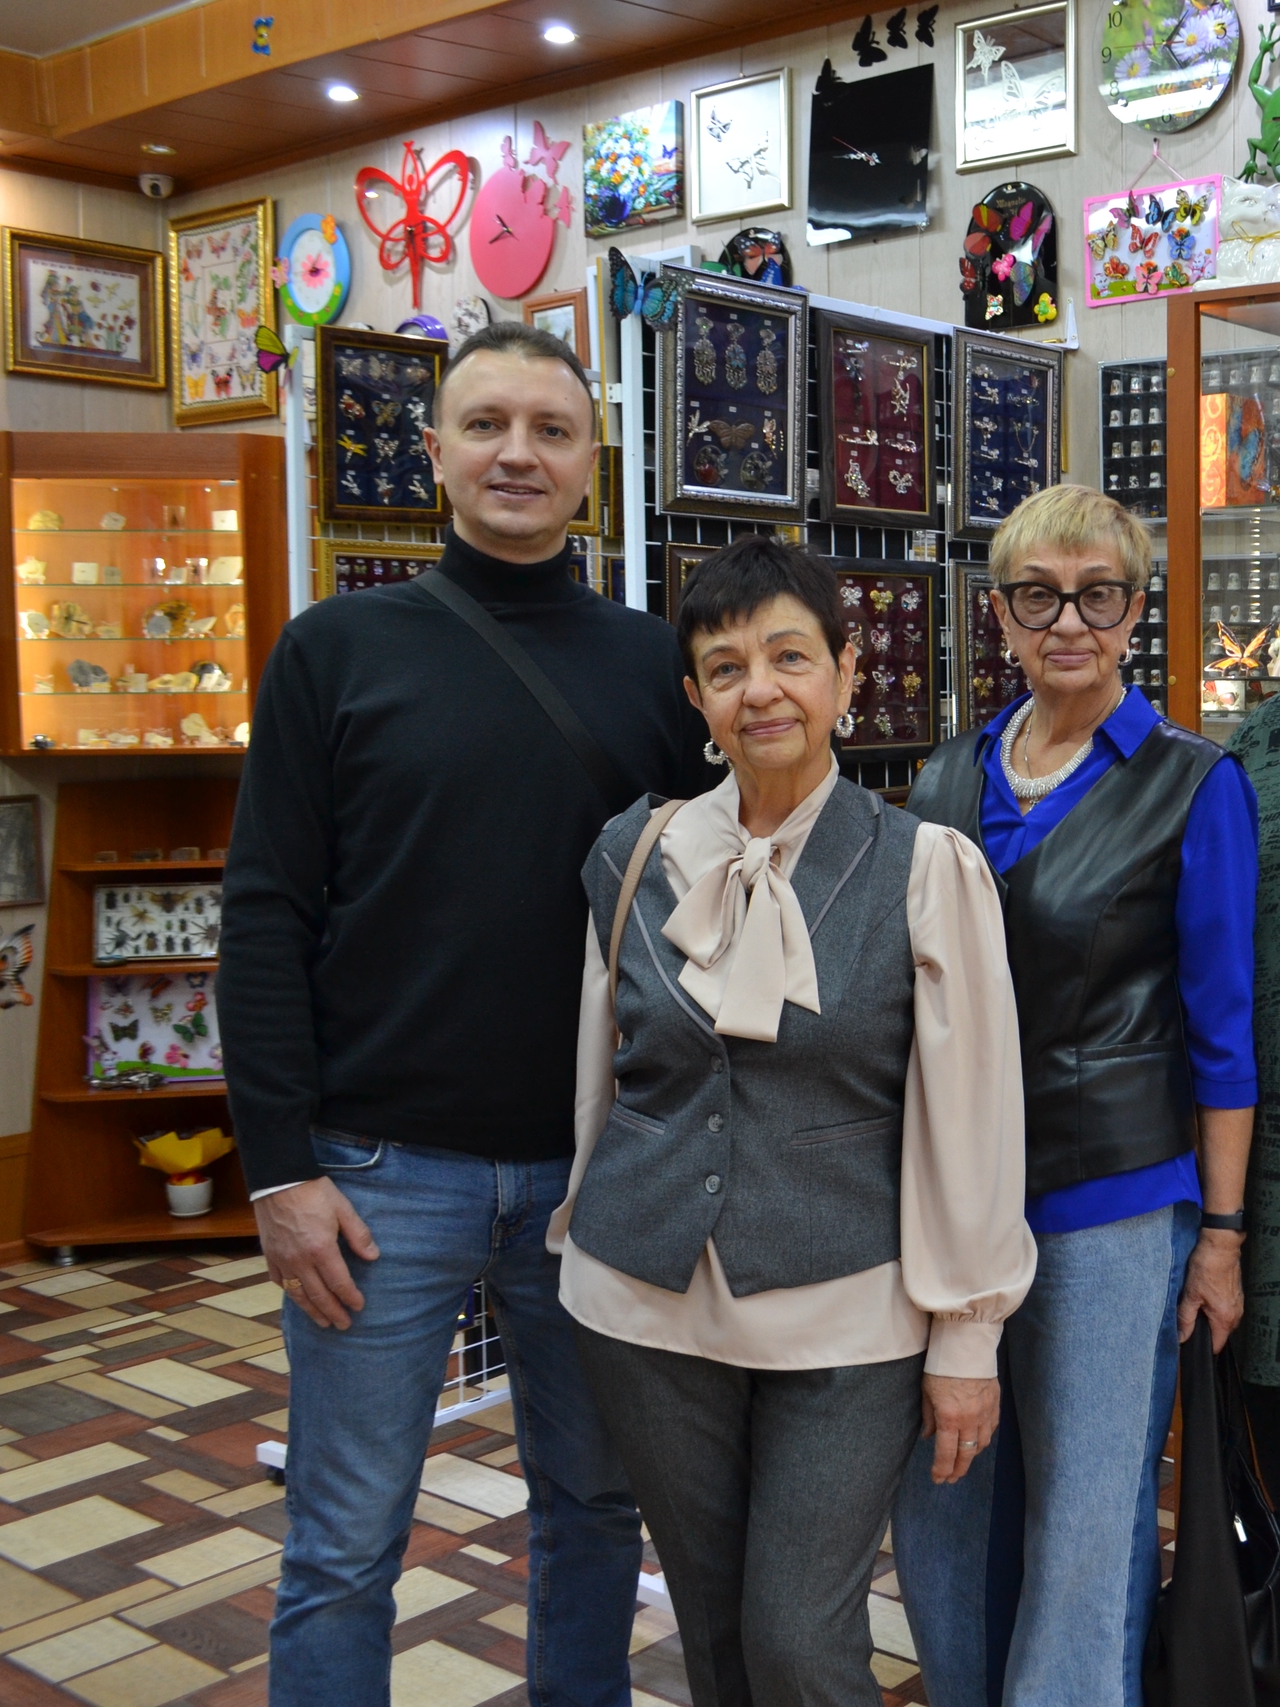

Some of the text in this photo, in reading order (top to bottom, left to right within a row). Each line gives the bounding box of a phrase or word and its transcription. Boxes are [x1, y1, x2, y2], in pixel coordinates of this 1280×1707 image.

[1108, 10, 1123, 29] 10
[1101, 46, 1112, 64] 9
[1109, 80, 1120, 97] 8
